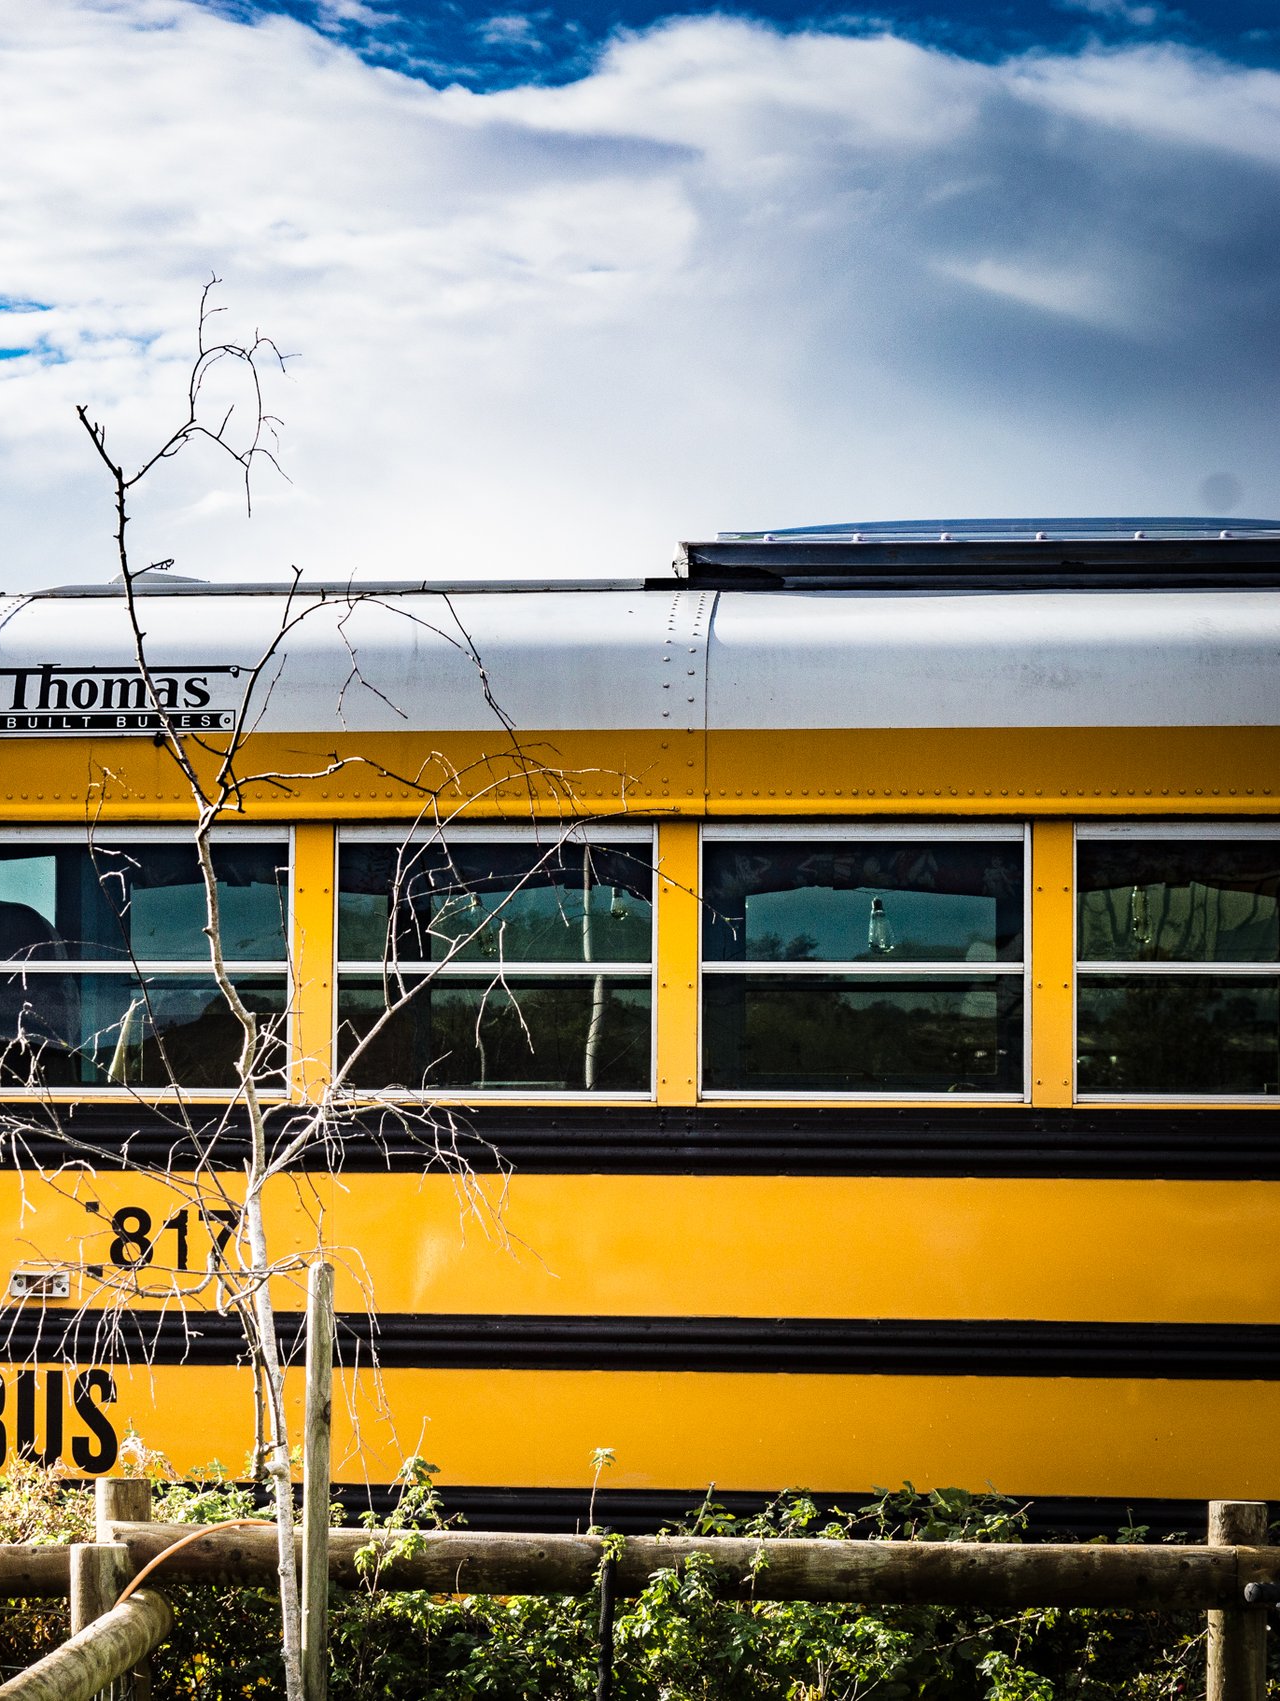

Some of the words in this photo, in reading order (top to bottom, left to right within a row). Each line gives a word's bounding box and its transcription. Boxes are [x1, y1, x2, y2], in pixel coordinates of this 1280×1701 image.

[9, 664, 211, 710] Thomas
[7, 717, 91, 728] BUILT
[109, 1206, 248, 1271] 817
